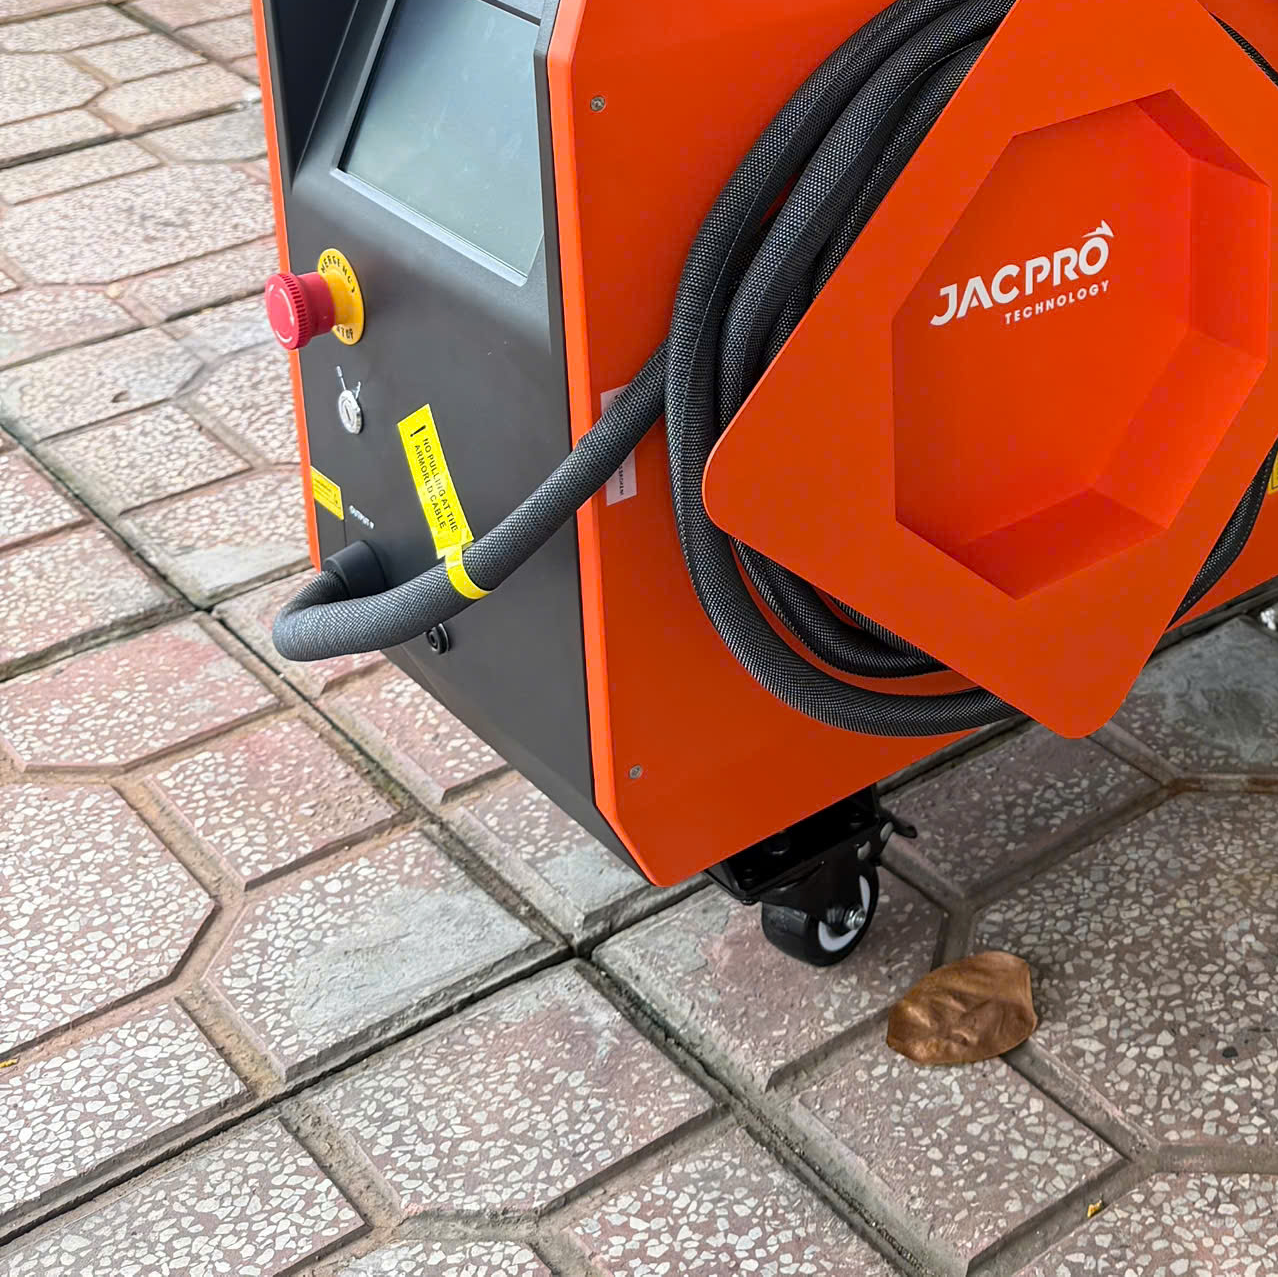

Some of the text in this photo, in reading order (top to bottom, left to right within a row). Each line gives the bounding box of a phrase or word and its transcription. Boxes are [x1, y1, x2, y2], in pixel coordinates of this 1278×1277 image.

[320, 254, 355, 293] MERGENCY
[930, 237, 1109, 326] JACPRO
[1005, 280, 1109, 325] TECHNOLOGY
[423, 437, 432, 453] NO
[441, 498, 451, 511] AT
[447, 511, 459, 533] THE
[430, 494, 447, 529] CABLE
